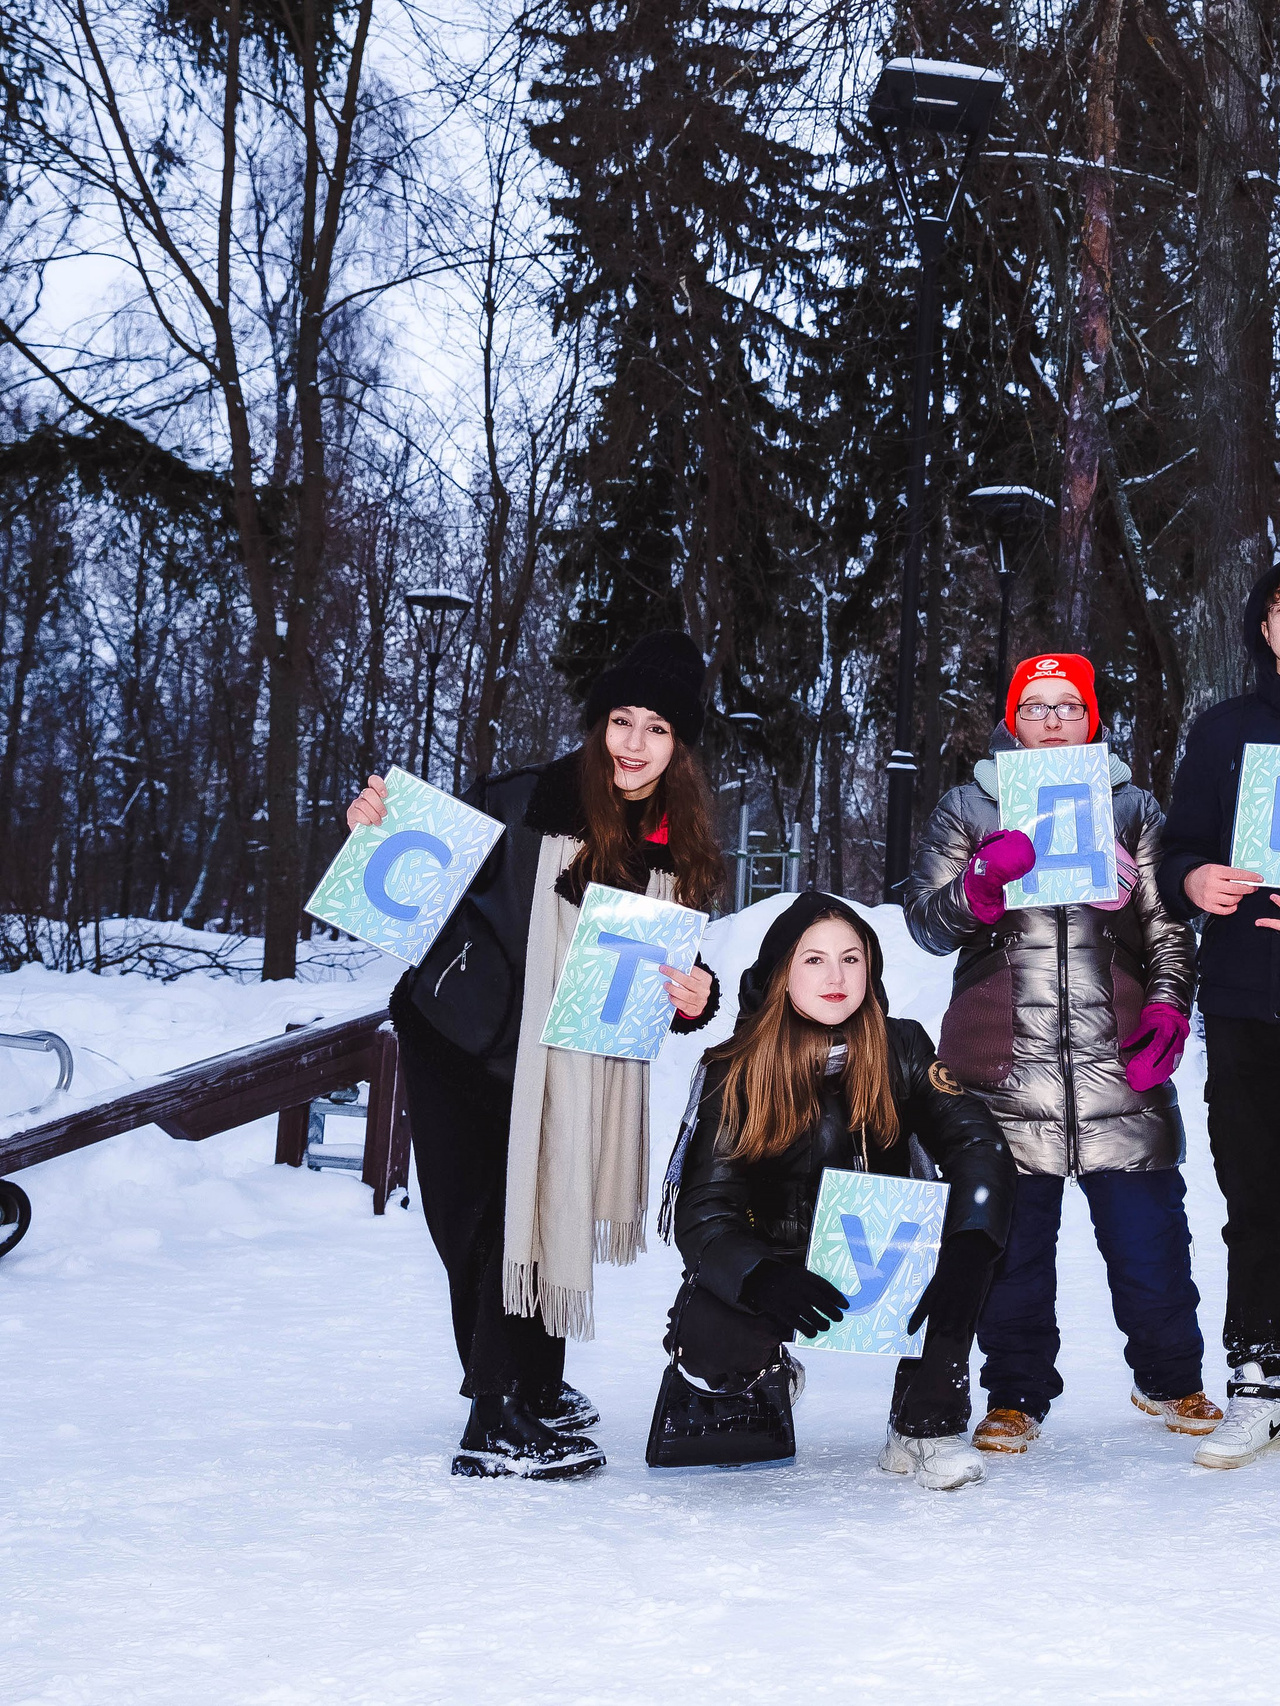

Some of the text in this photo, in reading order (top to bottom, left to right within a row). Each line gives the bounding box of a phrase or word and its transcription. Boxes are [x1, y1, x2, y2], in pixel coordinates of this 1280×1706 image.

[363, 829, 452, 922] С
[1022, 783, 1108, 894] Д
[597, 931, 668, 1025] Т
[837, 1213, 921, 1316] У
[1242, 1386, 1260, 1394] NIKE
